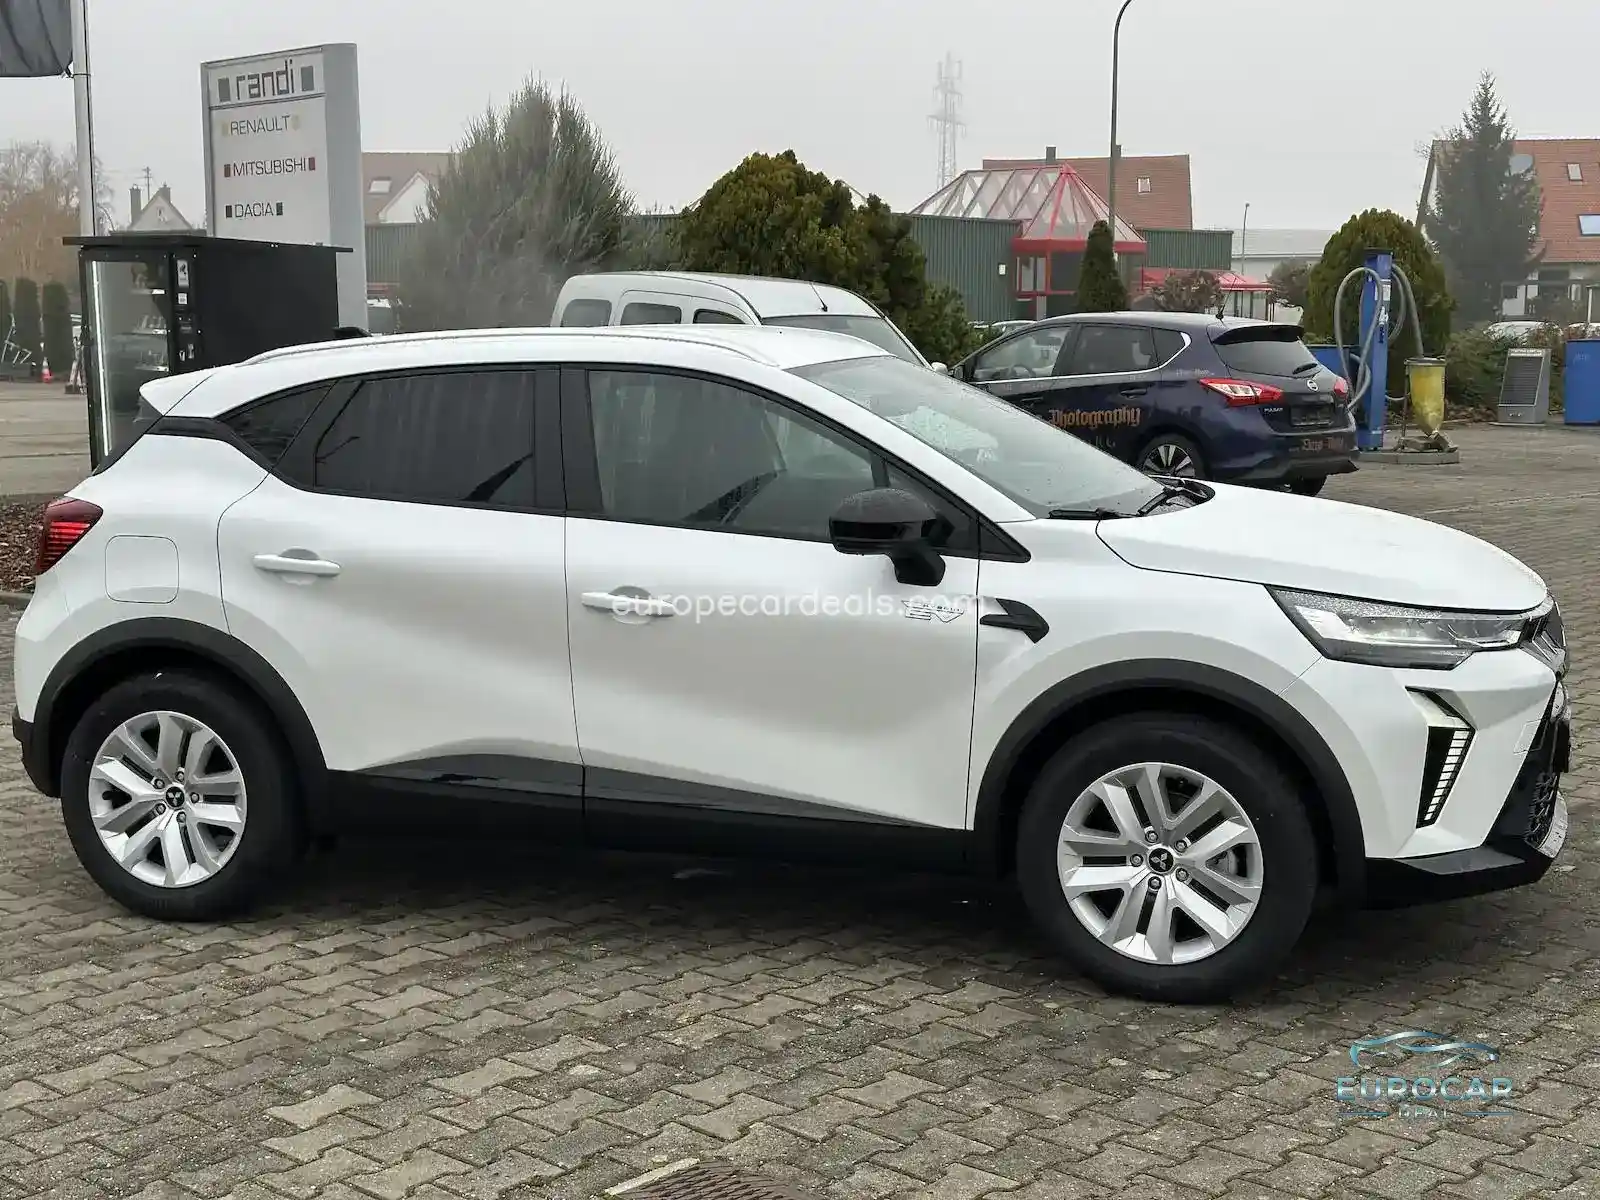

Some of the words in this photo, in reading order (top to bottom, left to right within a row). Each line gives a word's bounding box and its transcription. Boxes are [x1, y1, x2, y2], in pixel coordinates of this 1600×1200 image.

[236, 59, 294, 100] randi
[230, 115, 290, 136] RENAULT
[233, 157, 307, 177] MITSUBISHI
[234, 202, 274, 218] DACIA
[1049, 405, 1141, 430] Photography
